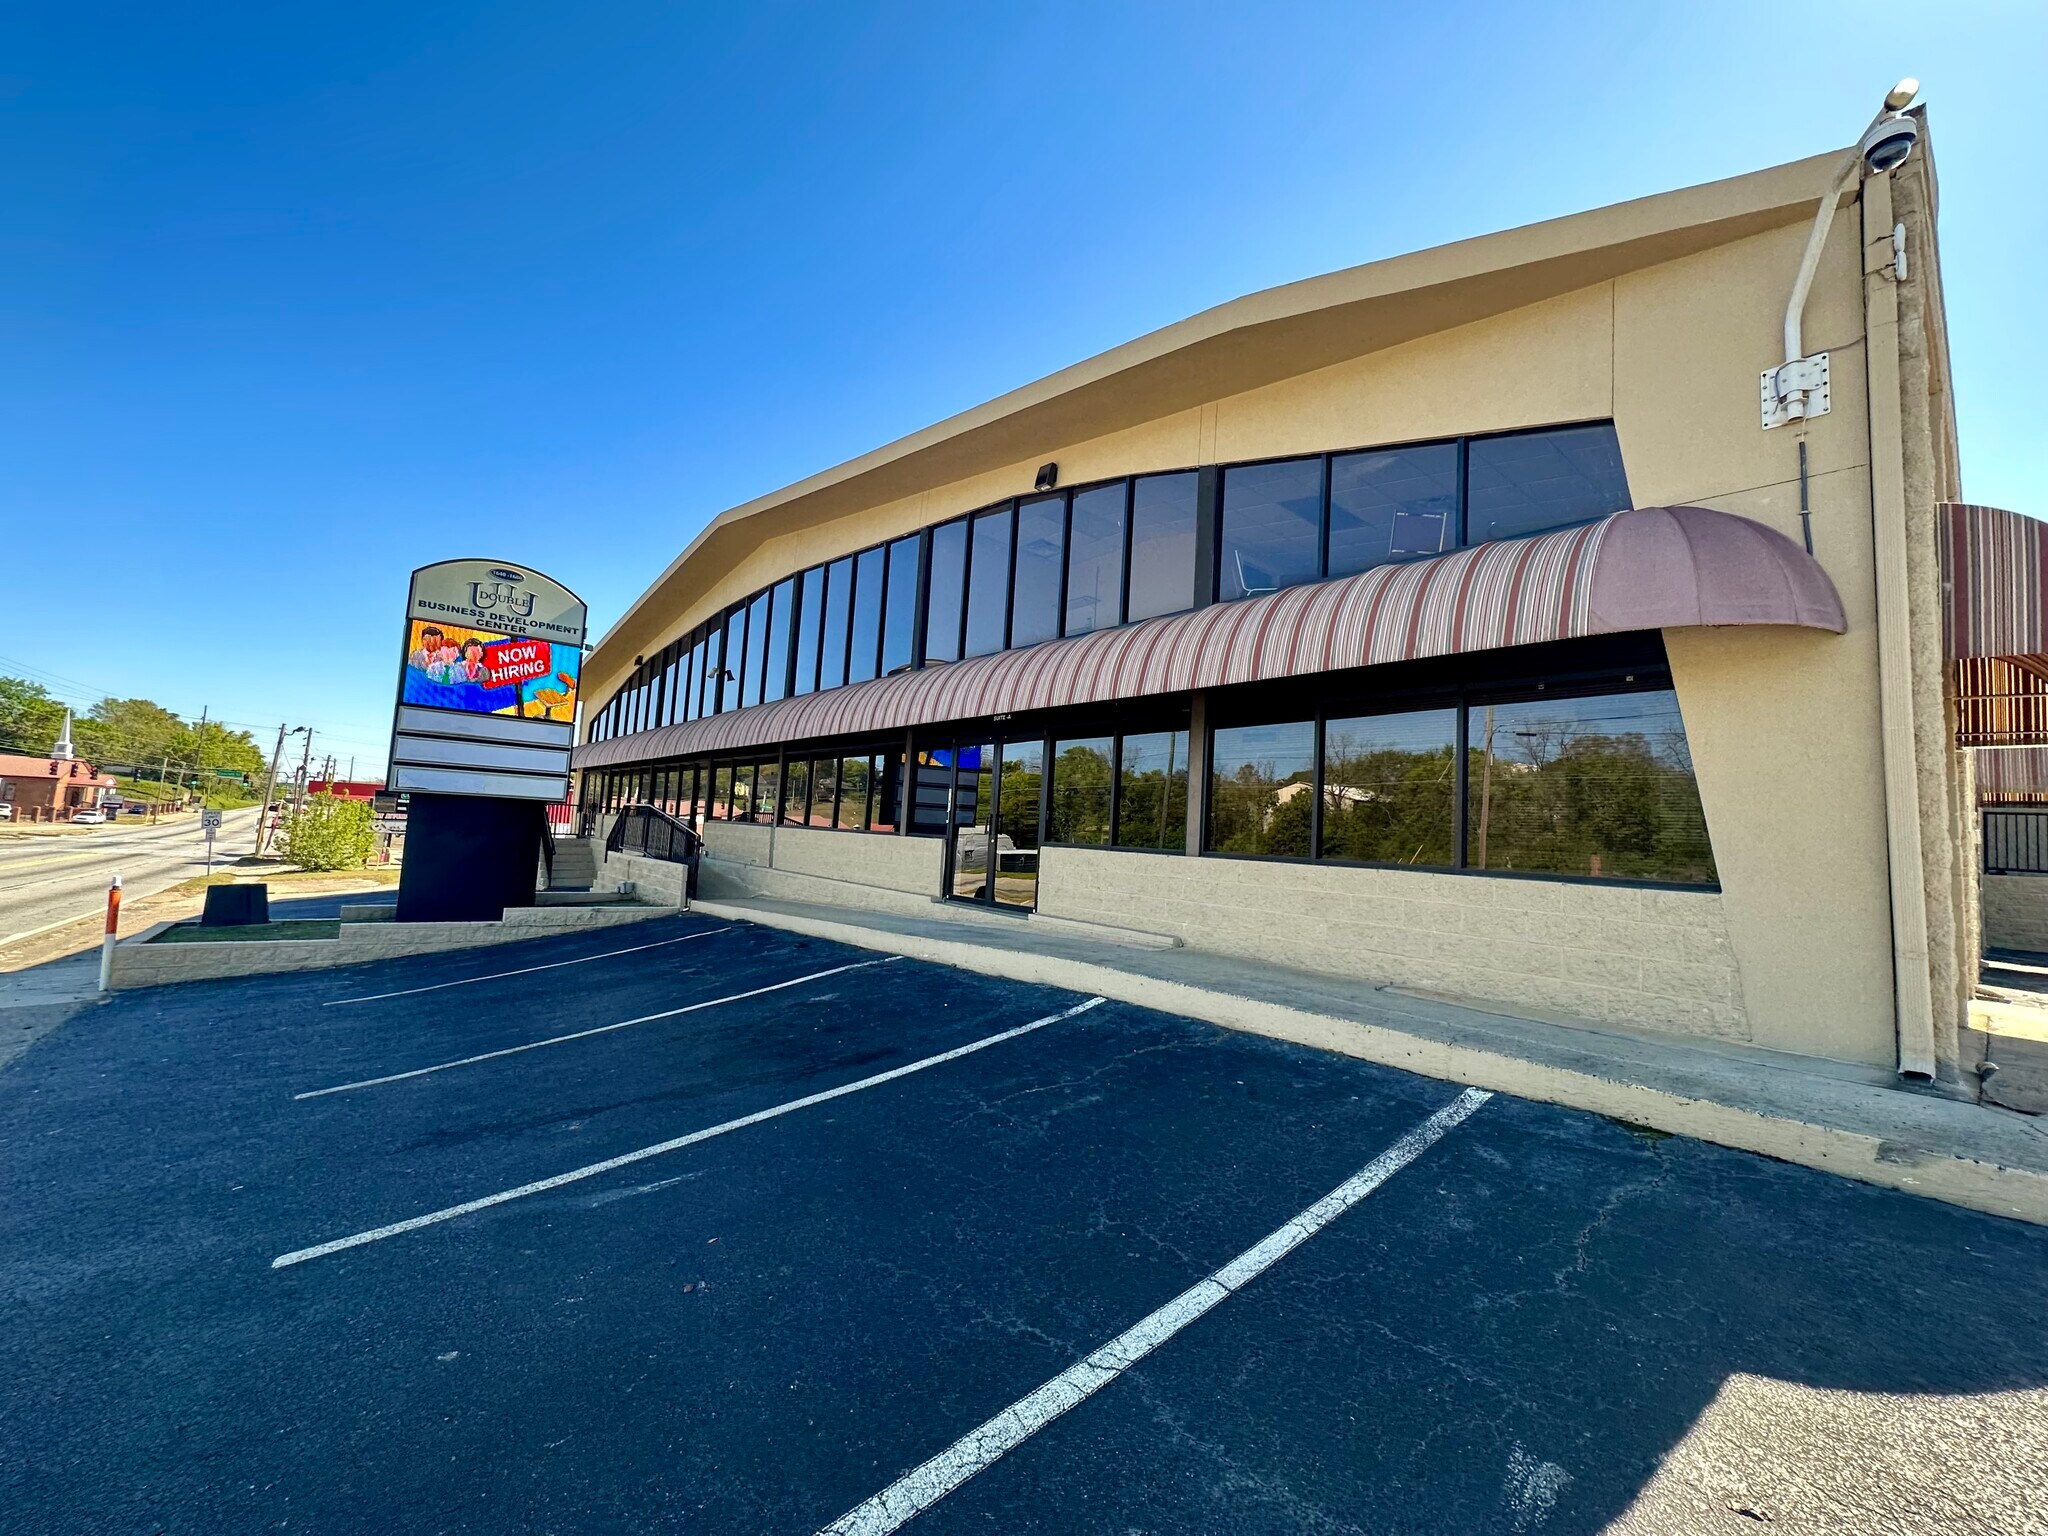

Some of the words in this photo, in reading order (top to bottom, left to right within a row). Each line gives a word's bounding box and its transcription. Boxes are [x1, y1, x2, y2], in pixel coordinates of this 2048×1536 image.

[479, 590, 530, 608] DOUBLE
[418, 599, 485, 618] BUSINESS
[489, 611, 580, 636] DEVELOPMENT
[476, 618, 527, 635] CENTER
[498, 645, 537, 664] NOW
[491, 659, 545, 682] HIRING
